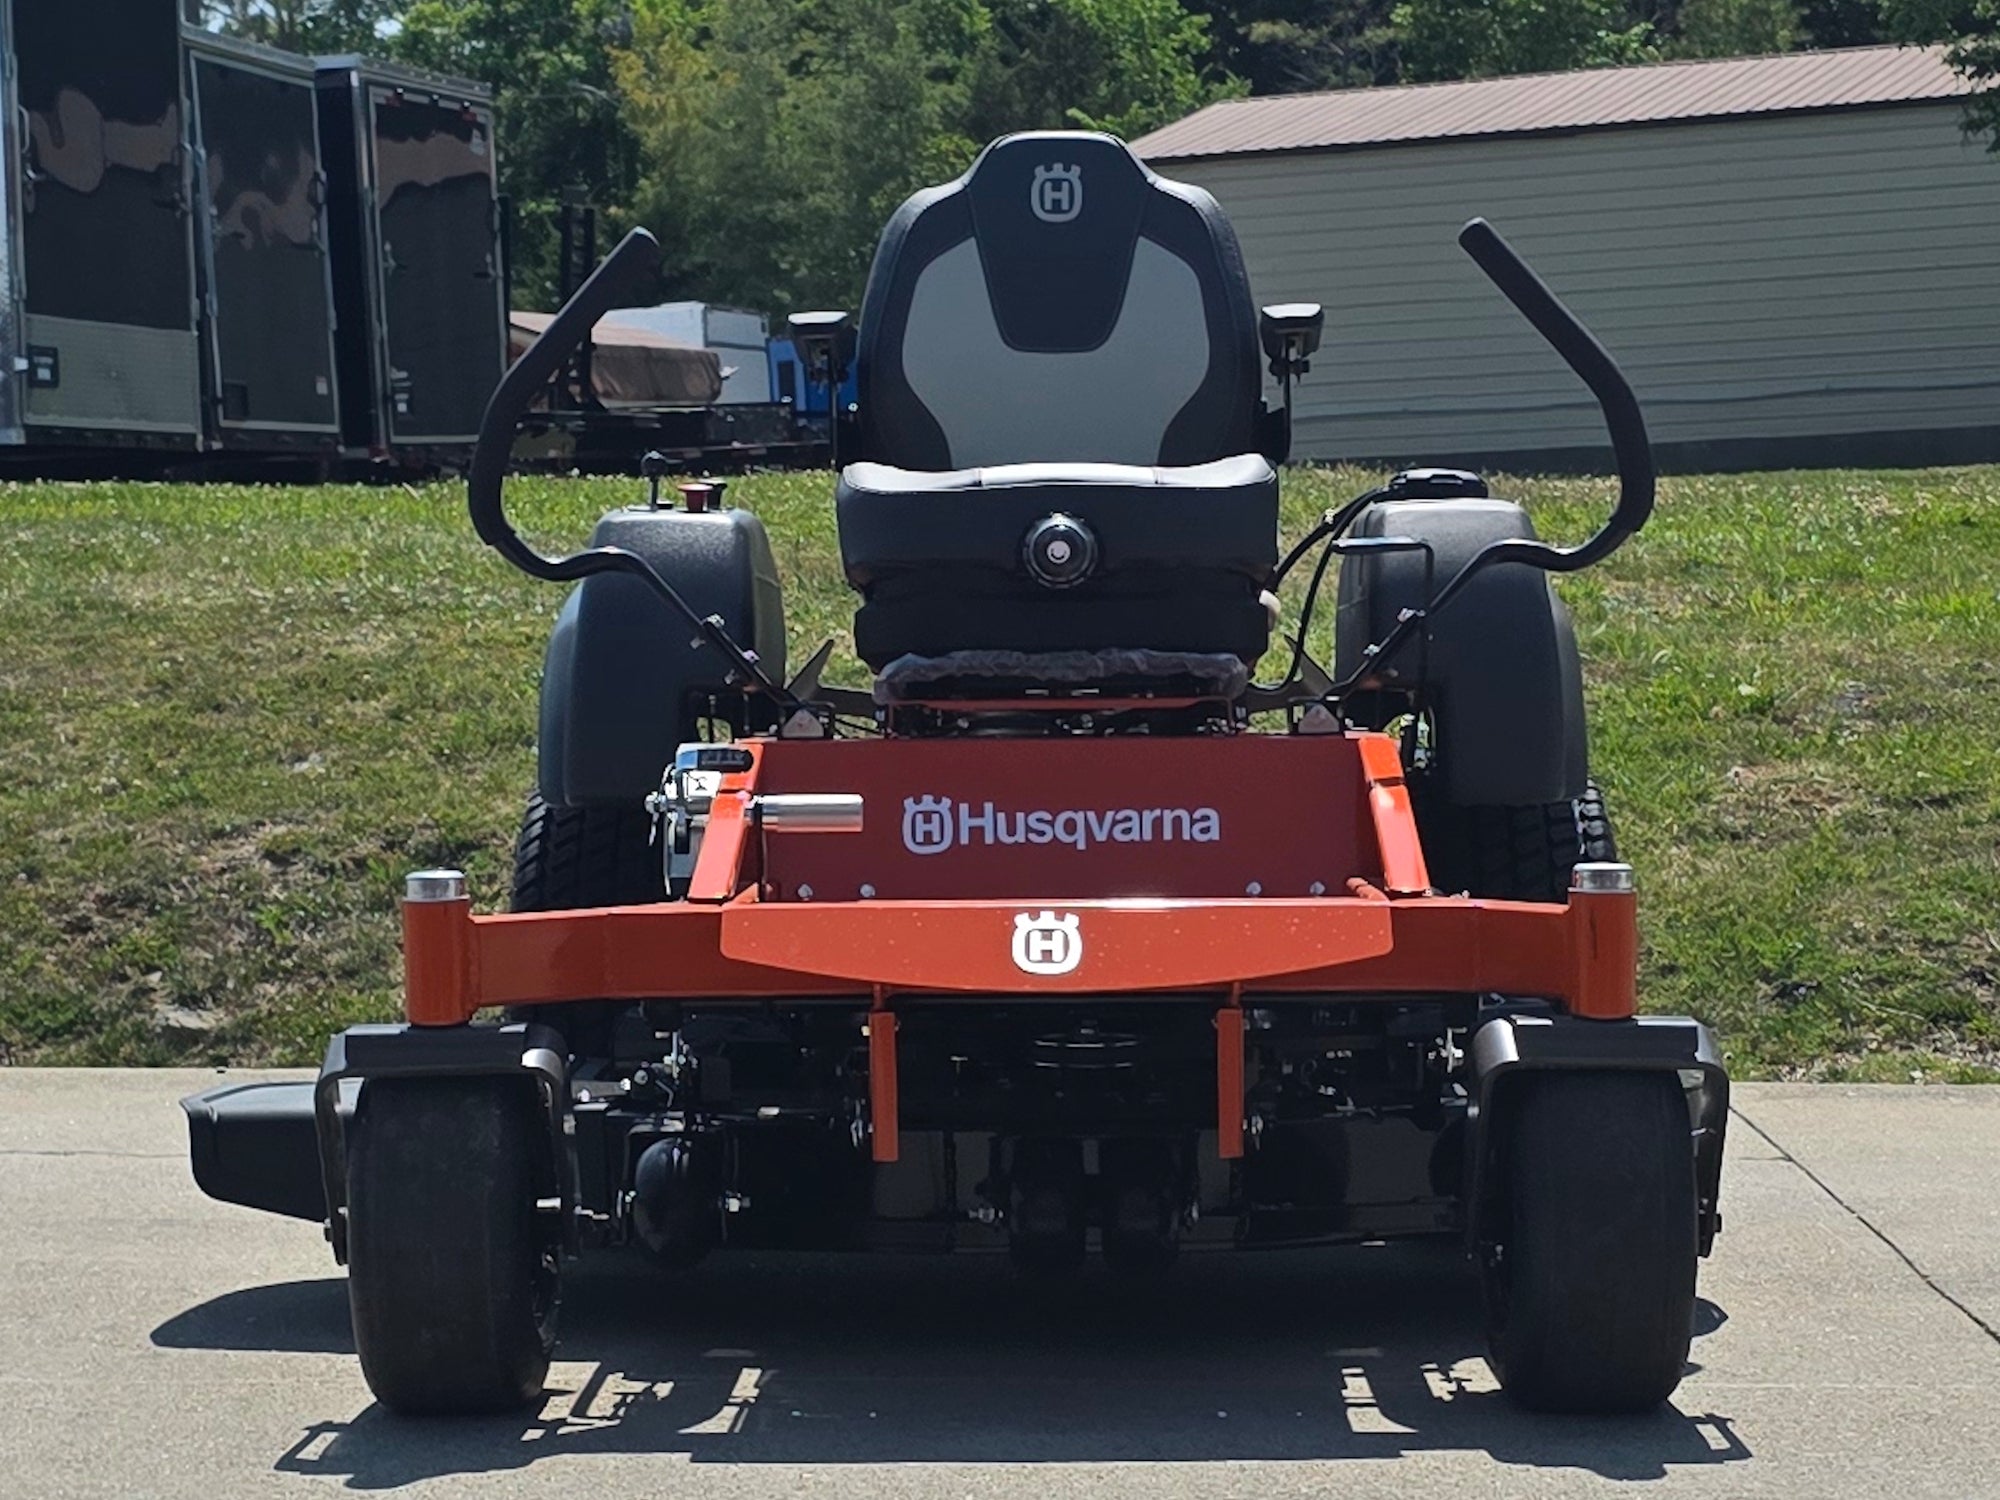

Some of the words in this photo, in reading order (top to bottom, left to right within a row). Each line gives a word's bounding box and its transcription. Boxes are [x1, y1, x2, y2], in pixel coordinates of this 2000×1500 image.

[1043, 180, 1070, 211] H
[914, 812, 941, 844] H
[958, 802, 1221, 851] Husqvarna
[1029, 929, 1065, 962] H
